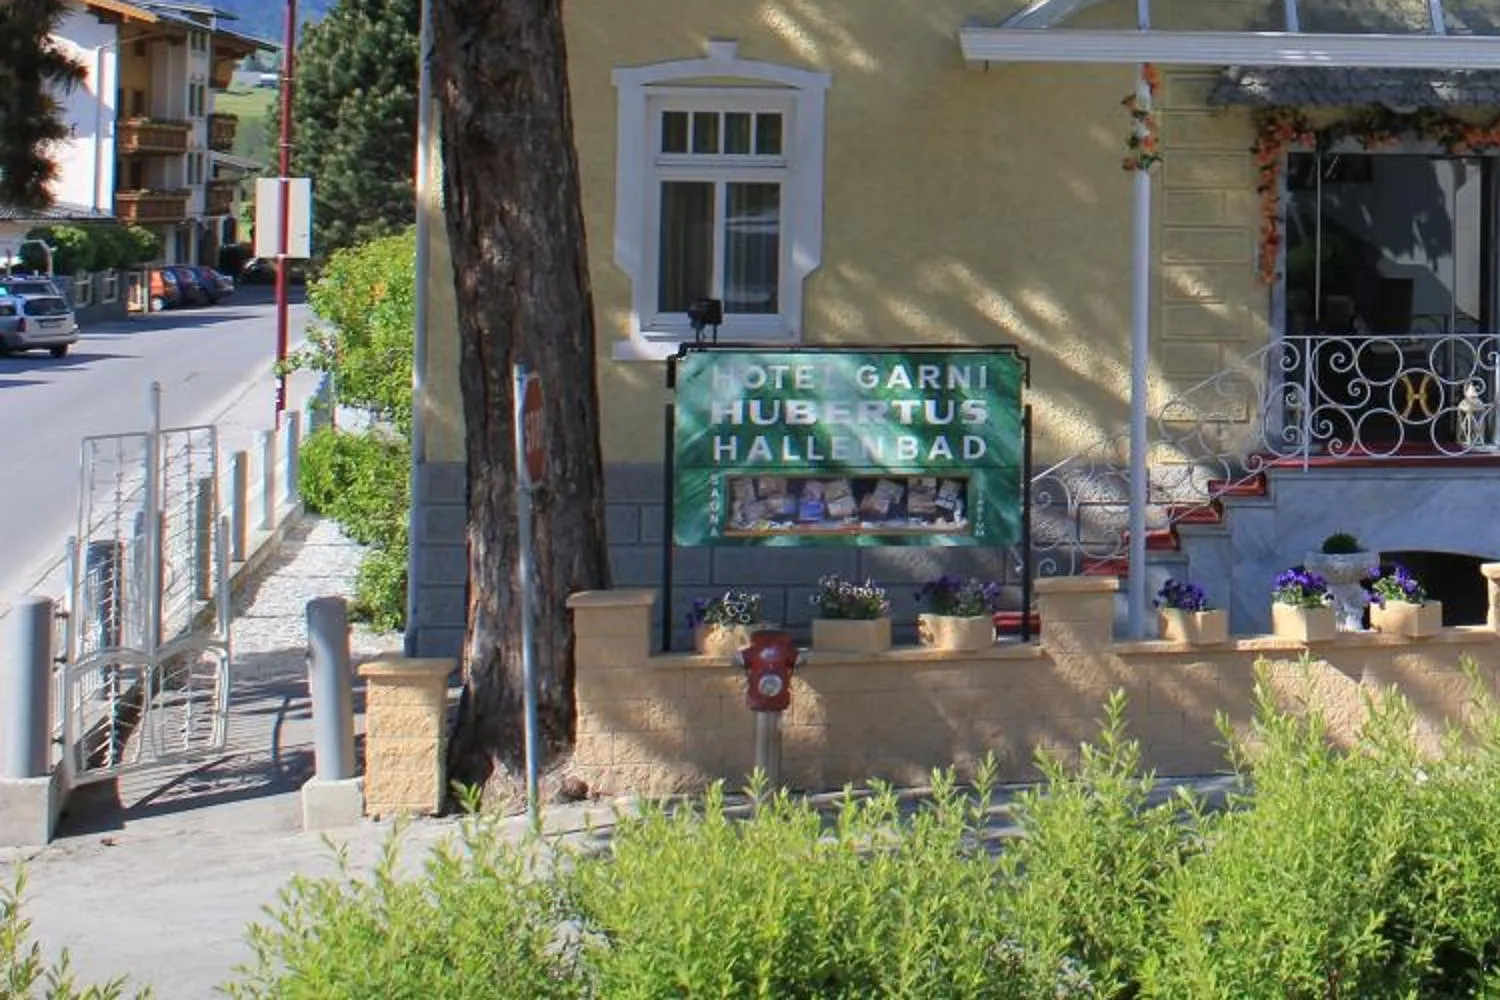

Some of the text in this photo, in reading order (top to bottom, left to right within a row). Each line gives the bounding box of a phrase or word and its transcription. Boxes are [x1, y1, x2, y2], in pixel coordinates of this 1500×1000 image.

[855, 364, 988, 389] GARNI
[711, 399, 989, 425] HUBERTUS
[713, 435, 988, 461] HALLENBAD
